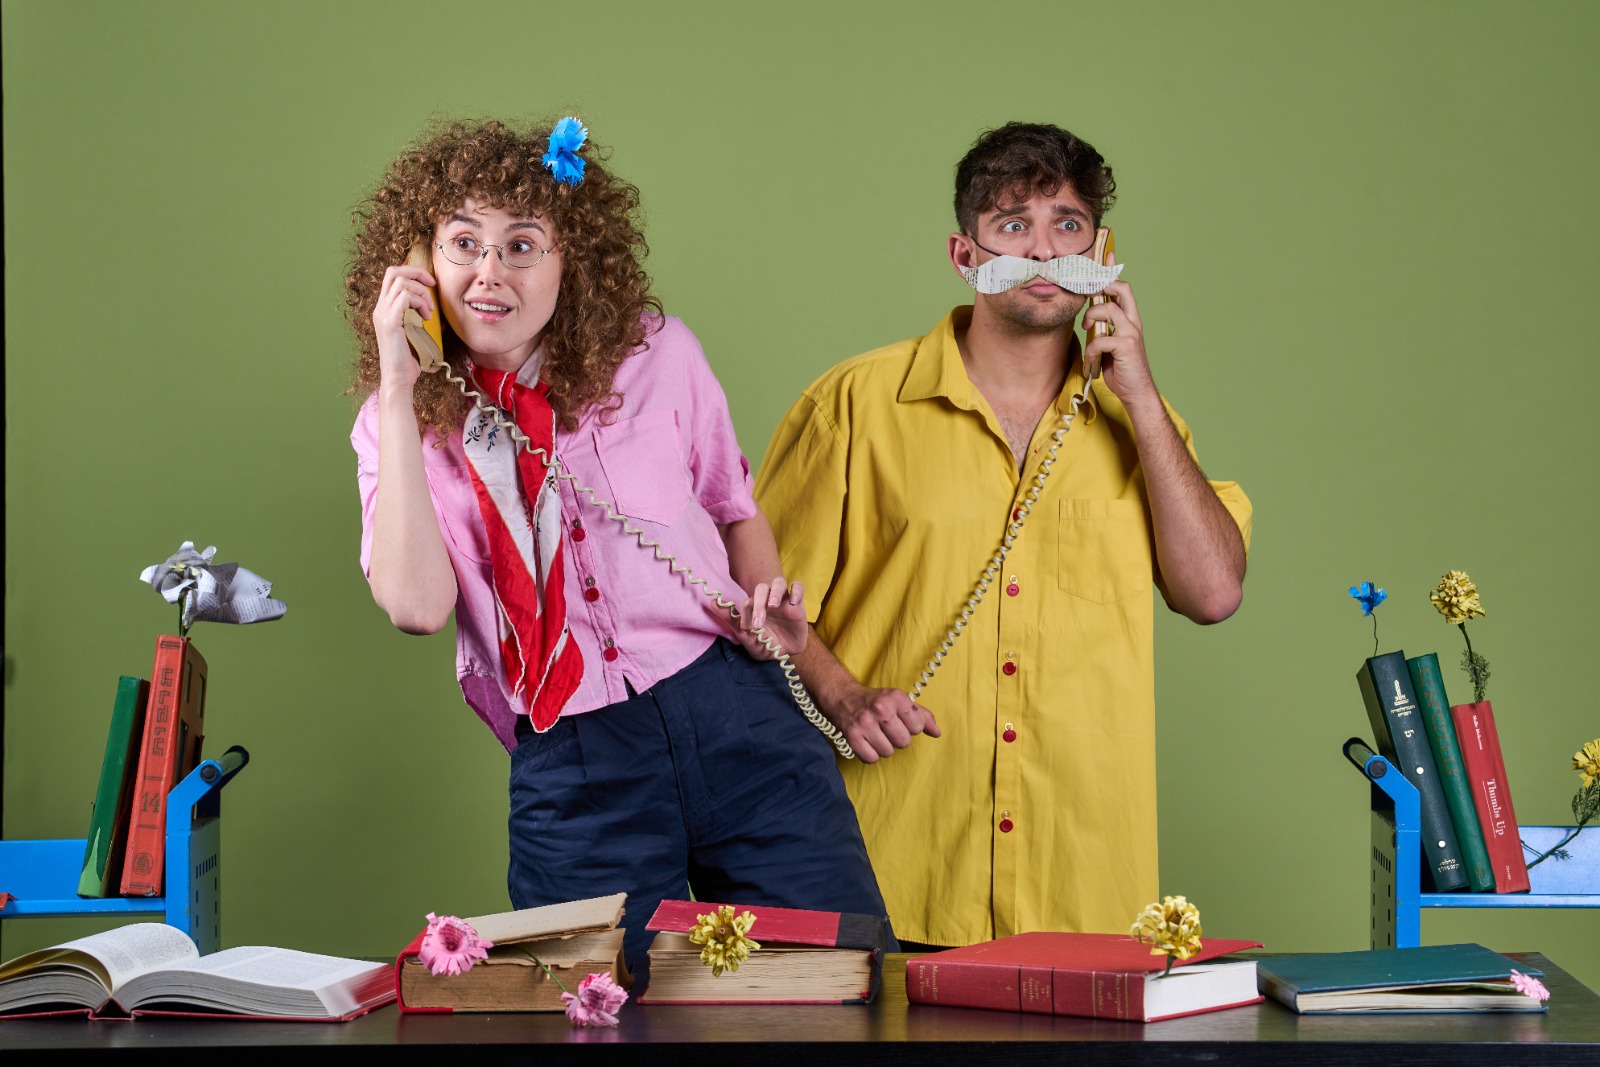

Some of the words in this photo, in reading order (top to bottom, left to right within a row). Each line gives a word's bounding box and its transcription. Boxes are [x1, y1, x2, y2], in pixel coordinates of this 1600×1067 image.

[152, 667, 174, 757] תרבות
[141, 792, 160, 814] 14
[1486, 778, 1502, 819] Thumbs
[1495, 820, 1506, 836] Up
